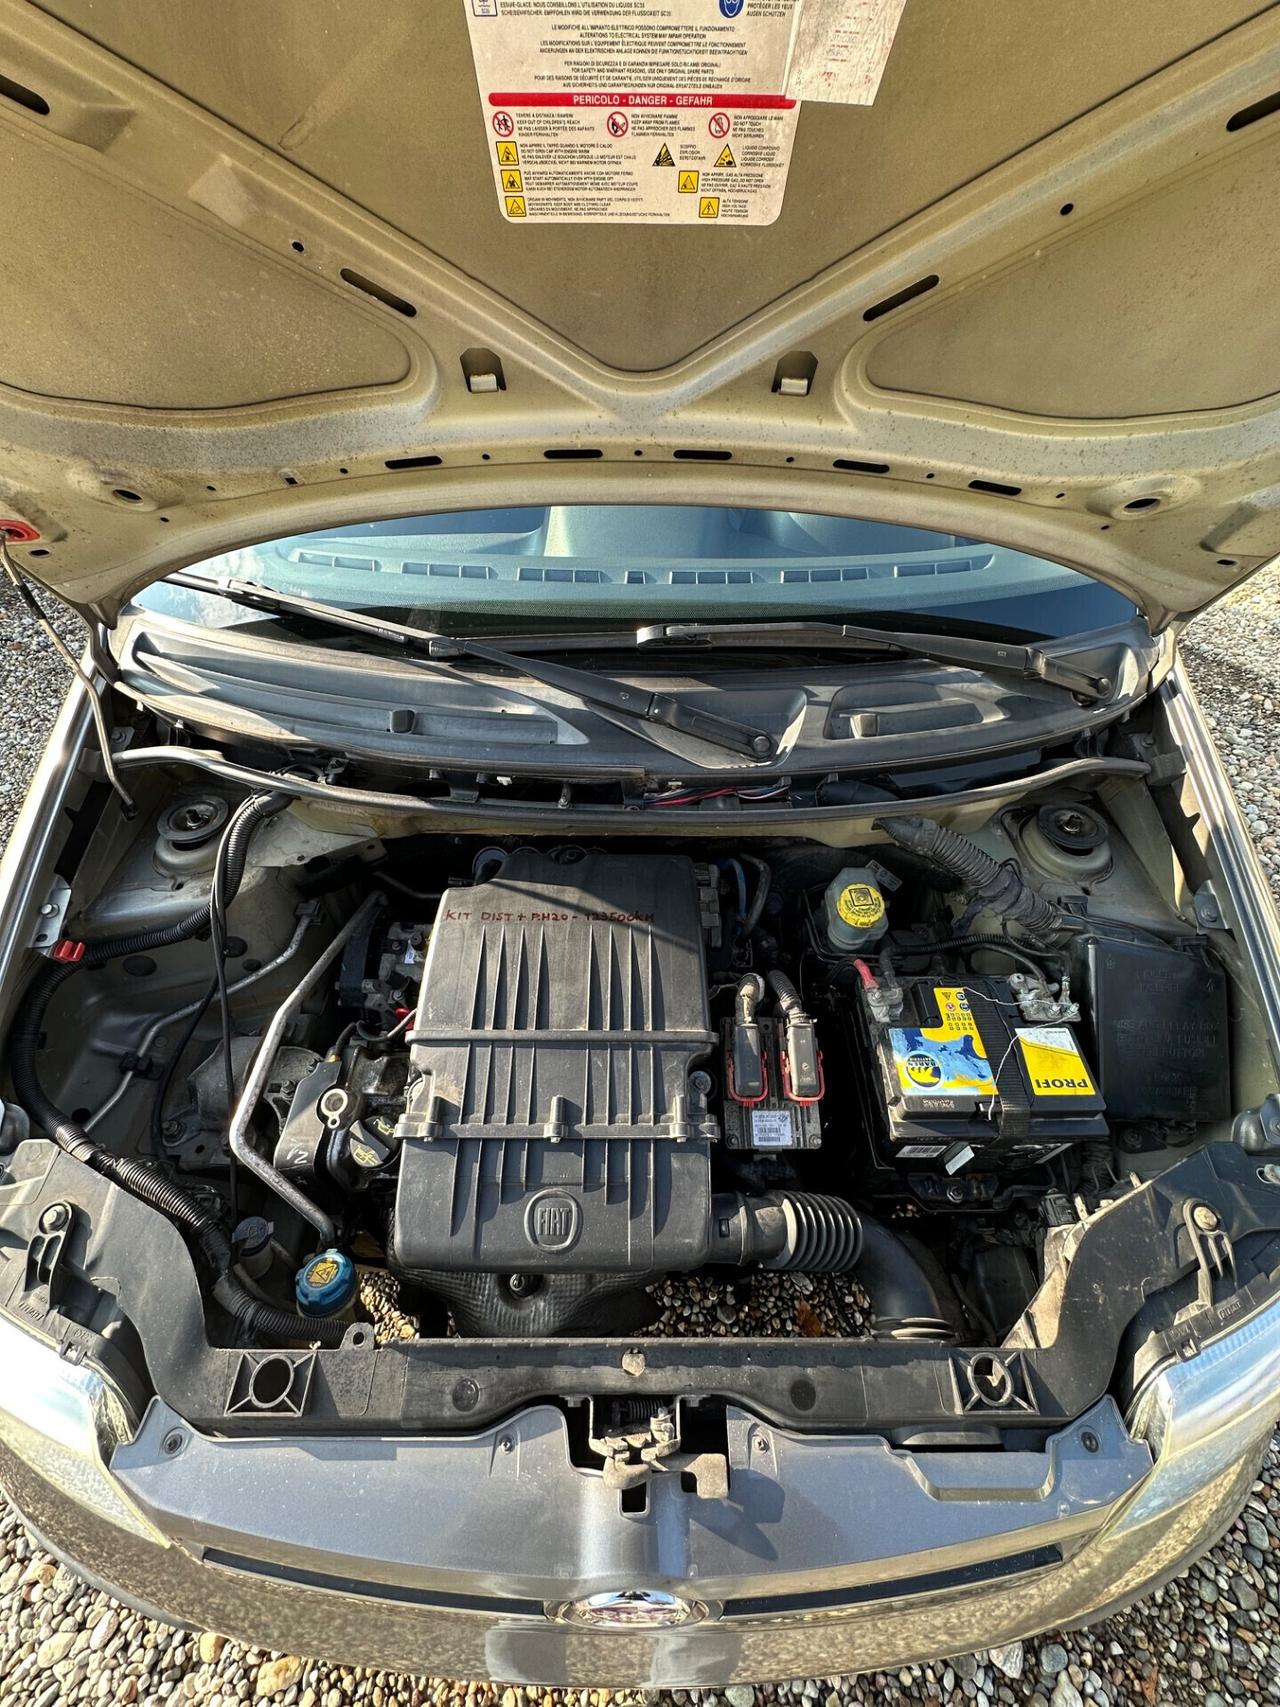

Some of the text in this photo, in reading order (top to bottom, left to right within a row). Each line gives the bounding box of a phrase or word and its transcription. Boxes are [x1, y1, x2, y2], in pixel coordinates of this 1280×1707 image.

[573, 95, 713, 105] PERICOLO DANGER GEFAHR
[446, 909, 472, 920] KIT
[481, 912, 514, 921] DIST
[517, 912, 526, 920] +
[1035, 1079, 1088, 1088] PROFI
[538, 1208, 570, 1236] FIAT
